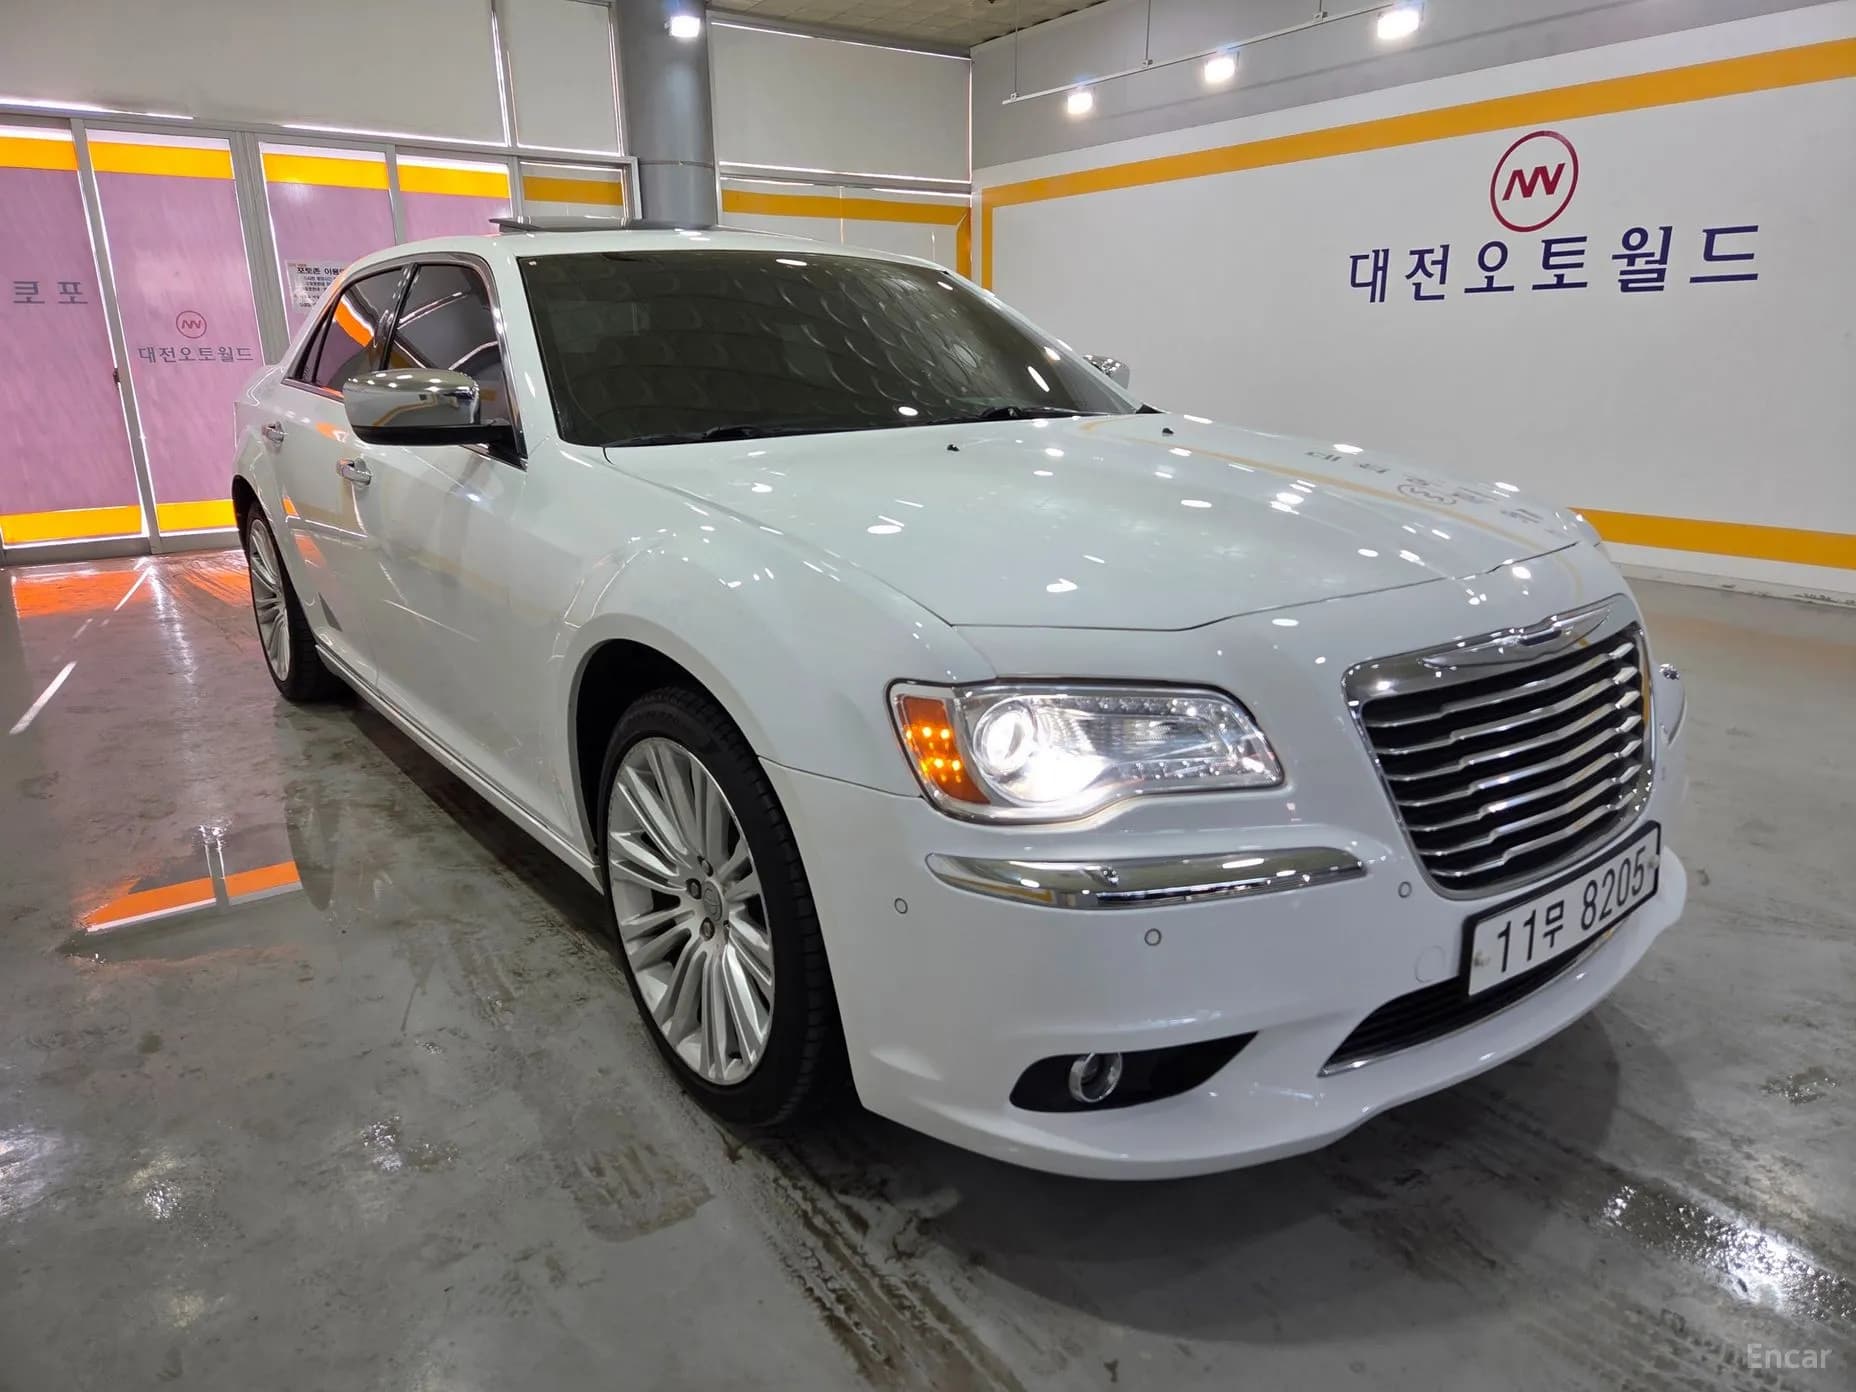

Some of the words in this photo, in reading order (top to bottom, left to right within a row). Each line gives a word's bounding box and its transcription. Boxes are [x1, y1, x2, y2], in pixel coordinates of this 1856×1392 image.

[1348, 224, 1759, 304] 대전오토월드
[138, 346, 254, 363] 대전오토월드
[1497, 900, 1565, 973] 11무
[1580, 846, 1647, 931] 8205
